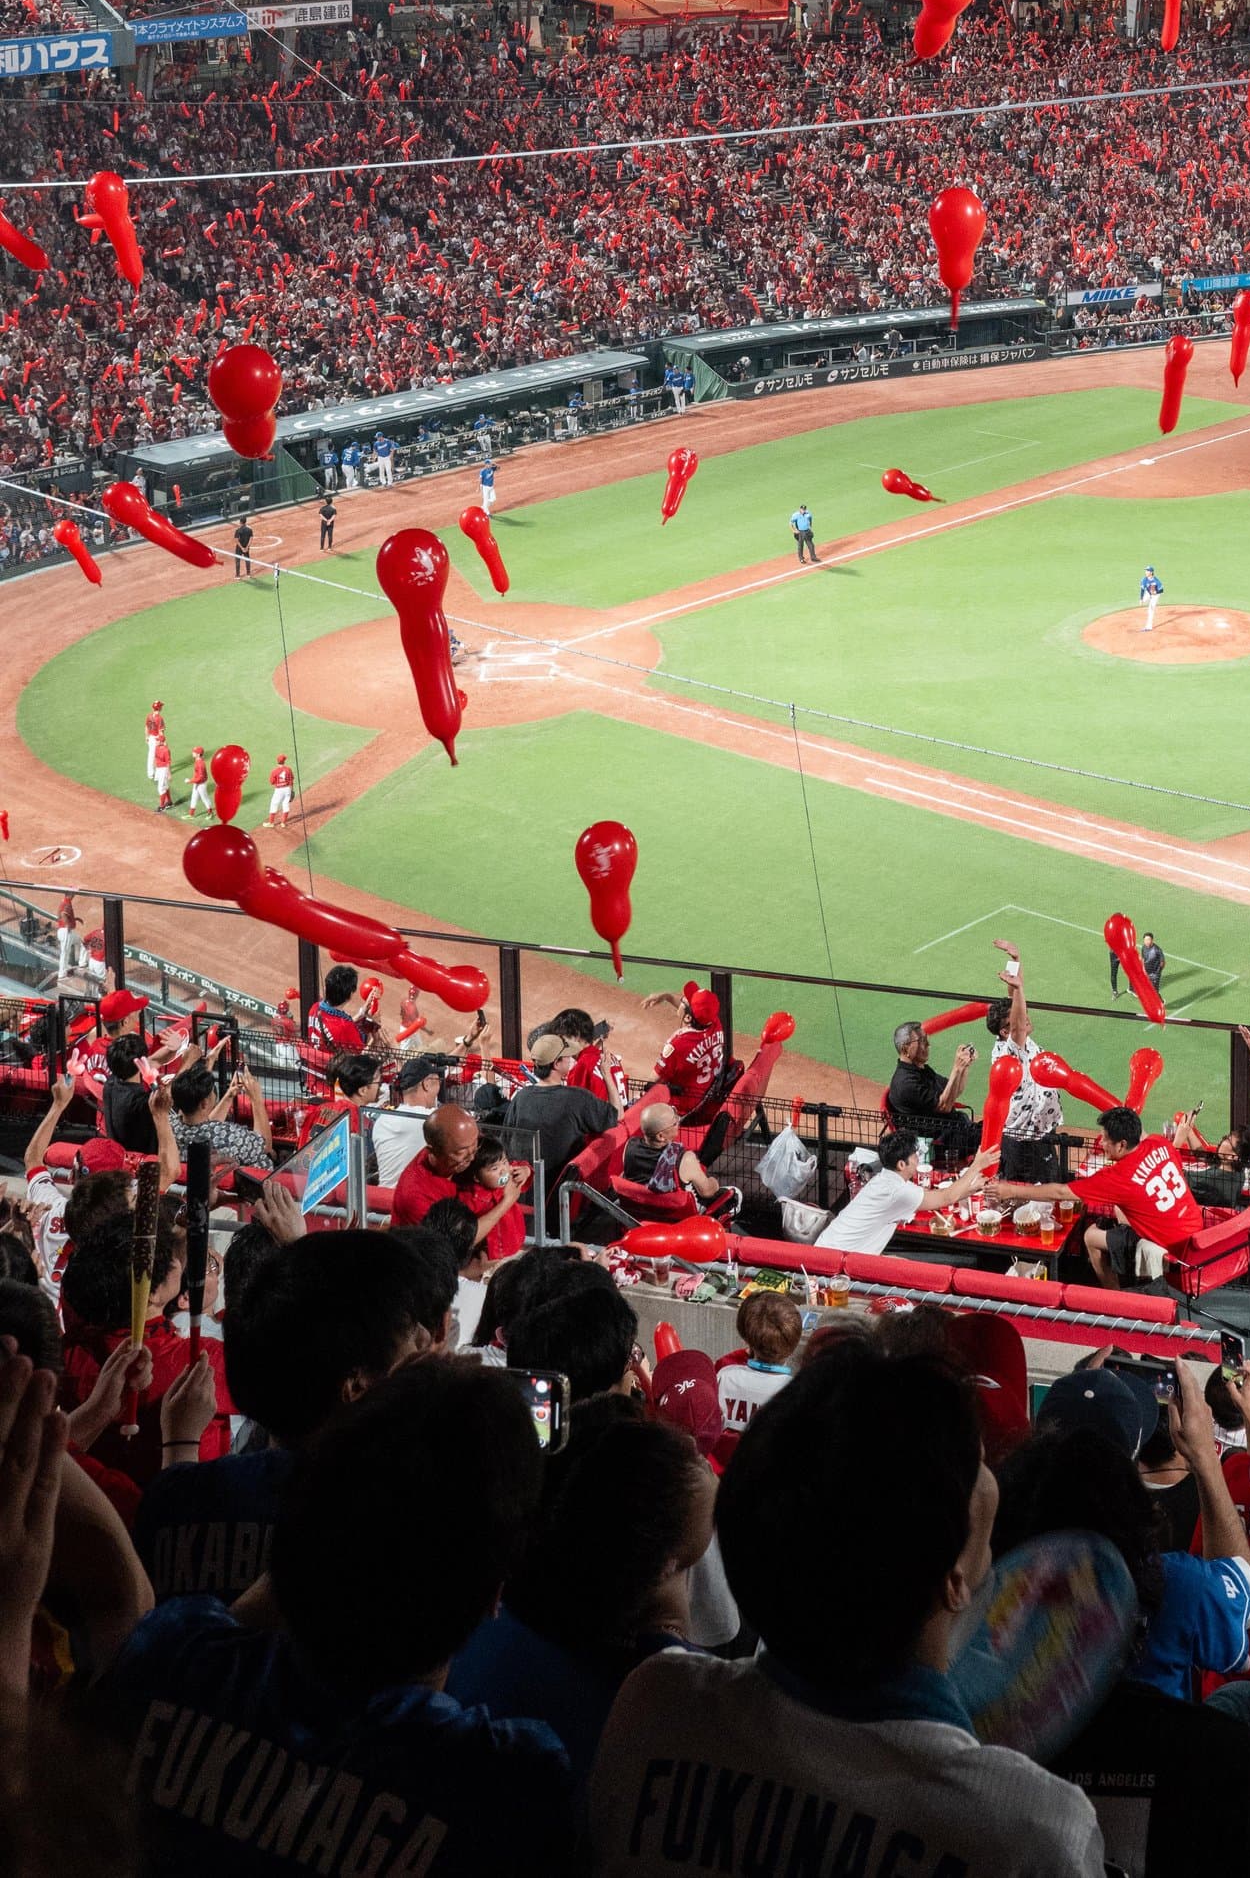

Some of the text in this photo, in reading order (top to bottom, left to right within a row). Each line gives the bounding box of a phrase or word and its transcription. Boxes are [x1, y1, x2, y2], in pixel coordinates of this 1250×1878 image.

[0, 38, 109, 73] 和ハウス
[1082, 286, 1138, 303] MIIKE
[765, 346, 1036, 391] サンセルモ サンセルモ 自動車保険は 損保ジャパン
[163, 964, 196, 984] エディオン
[225, 990, 259, 1010] エディオン
[686, 1030, 725, 1065] KIKUCH
[1131, 1145, 1171, 1187] KIKUCHI
[1145, 1161, 1187, 1212] 33
[128, 1698, 449, 1878] FUKUNAGA
[1098, 1772, 1157, 1789] ANGELES
[628, 1759, 967, 1878] FUKUNAG
